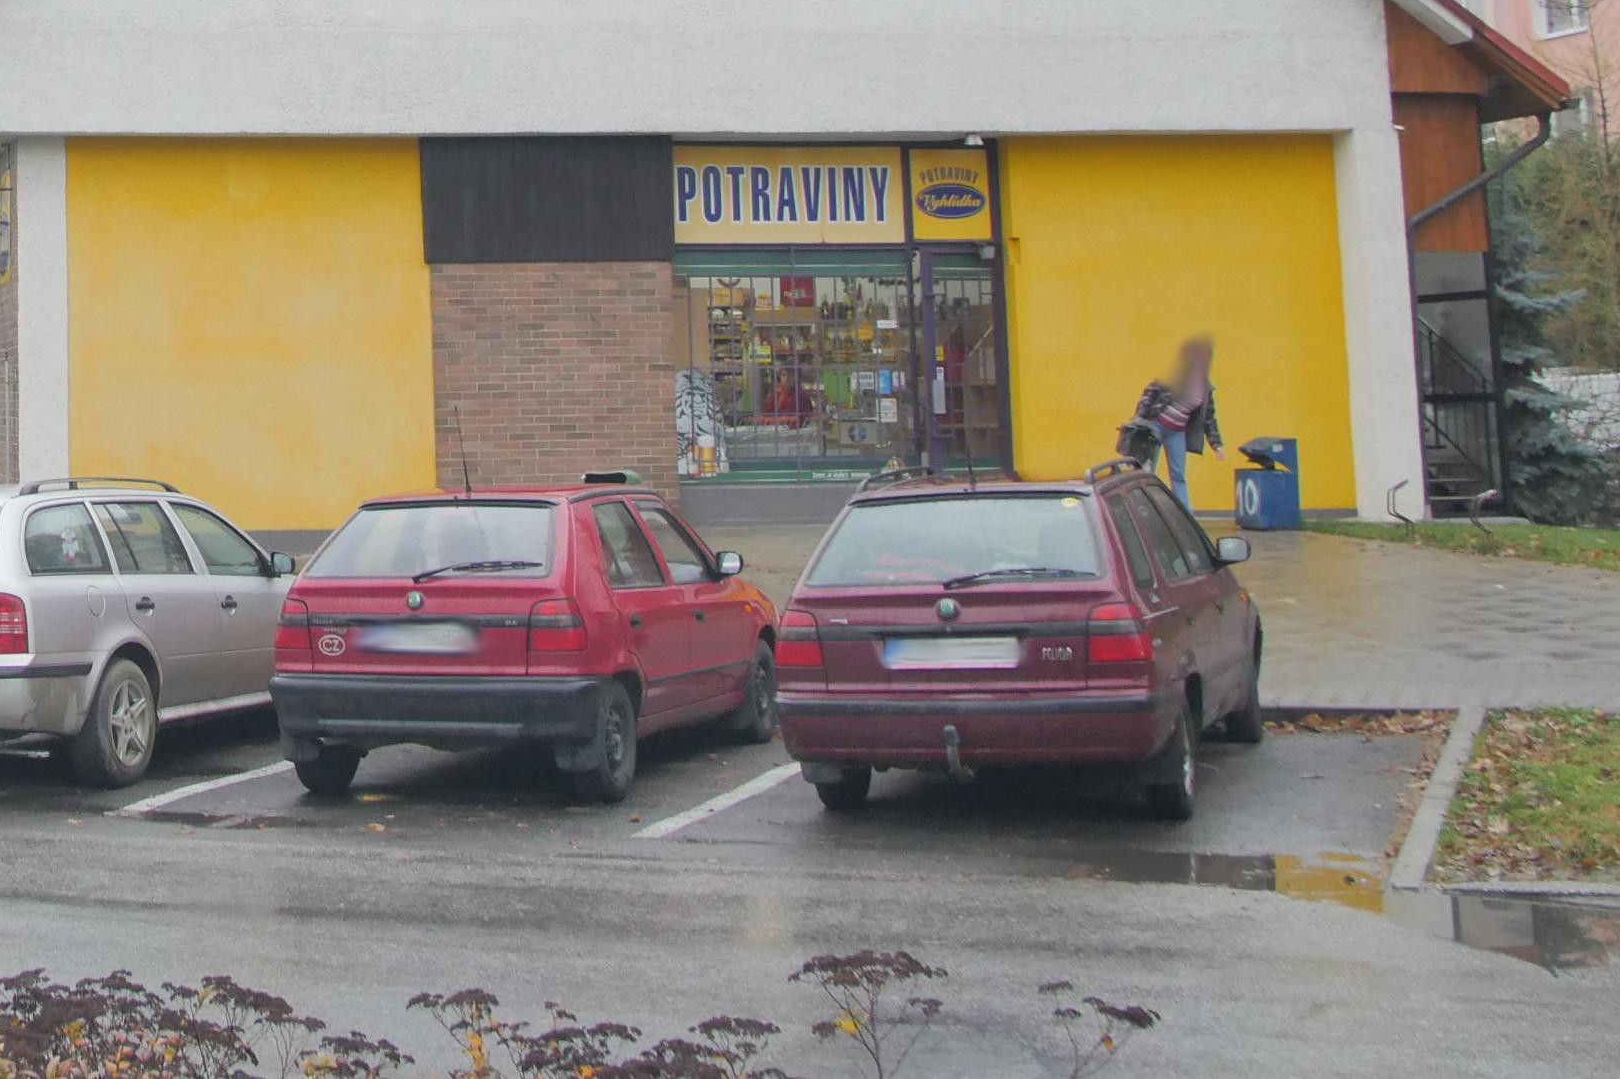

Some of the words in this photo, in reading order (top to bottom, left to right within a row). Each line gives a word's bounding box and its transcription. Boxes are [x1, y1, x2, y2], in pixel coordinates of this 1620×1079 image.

[919, 166, 980, 185] POTRAVINY
[675, 164, 890, 224] POTRAVINY
[1236, 478, 1259, 516] 10
[322, 639, 341, 652] CZ
